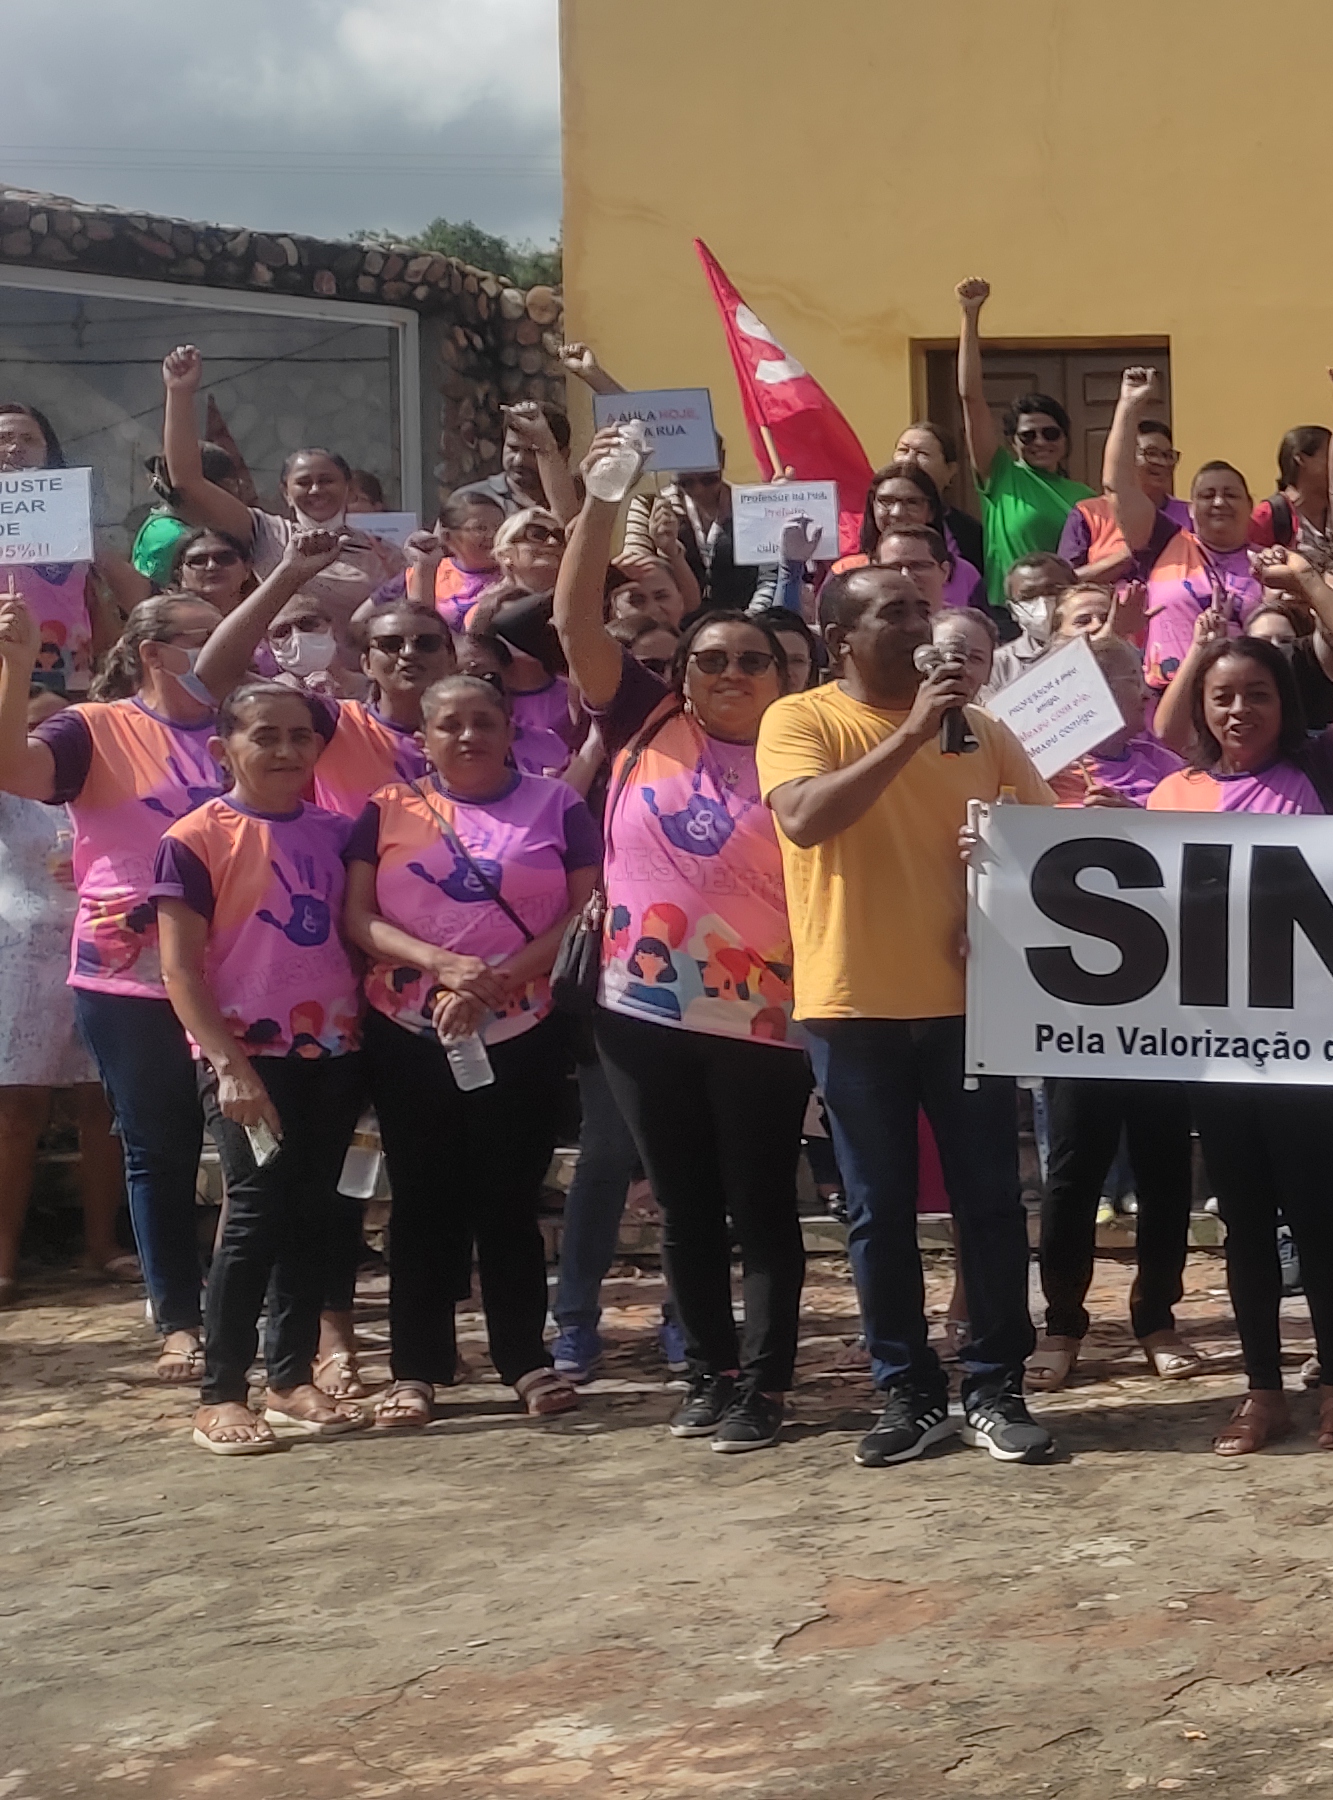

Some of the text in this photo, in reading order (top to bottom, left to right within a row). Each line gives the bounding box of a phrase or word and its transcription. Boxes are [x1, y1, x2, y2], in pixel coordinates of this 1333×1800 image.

[655, 425, 687, 437] RUA
[1035, 1023, 1105, 1055] Pela
[1117, 1025, 1311, 1067] Valorização
